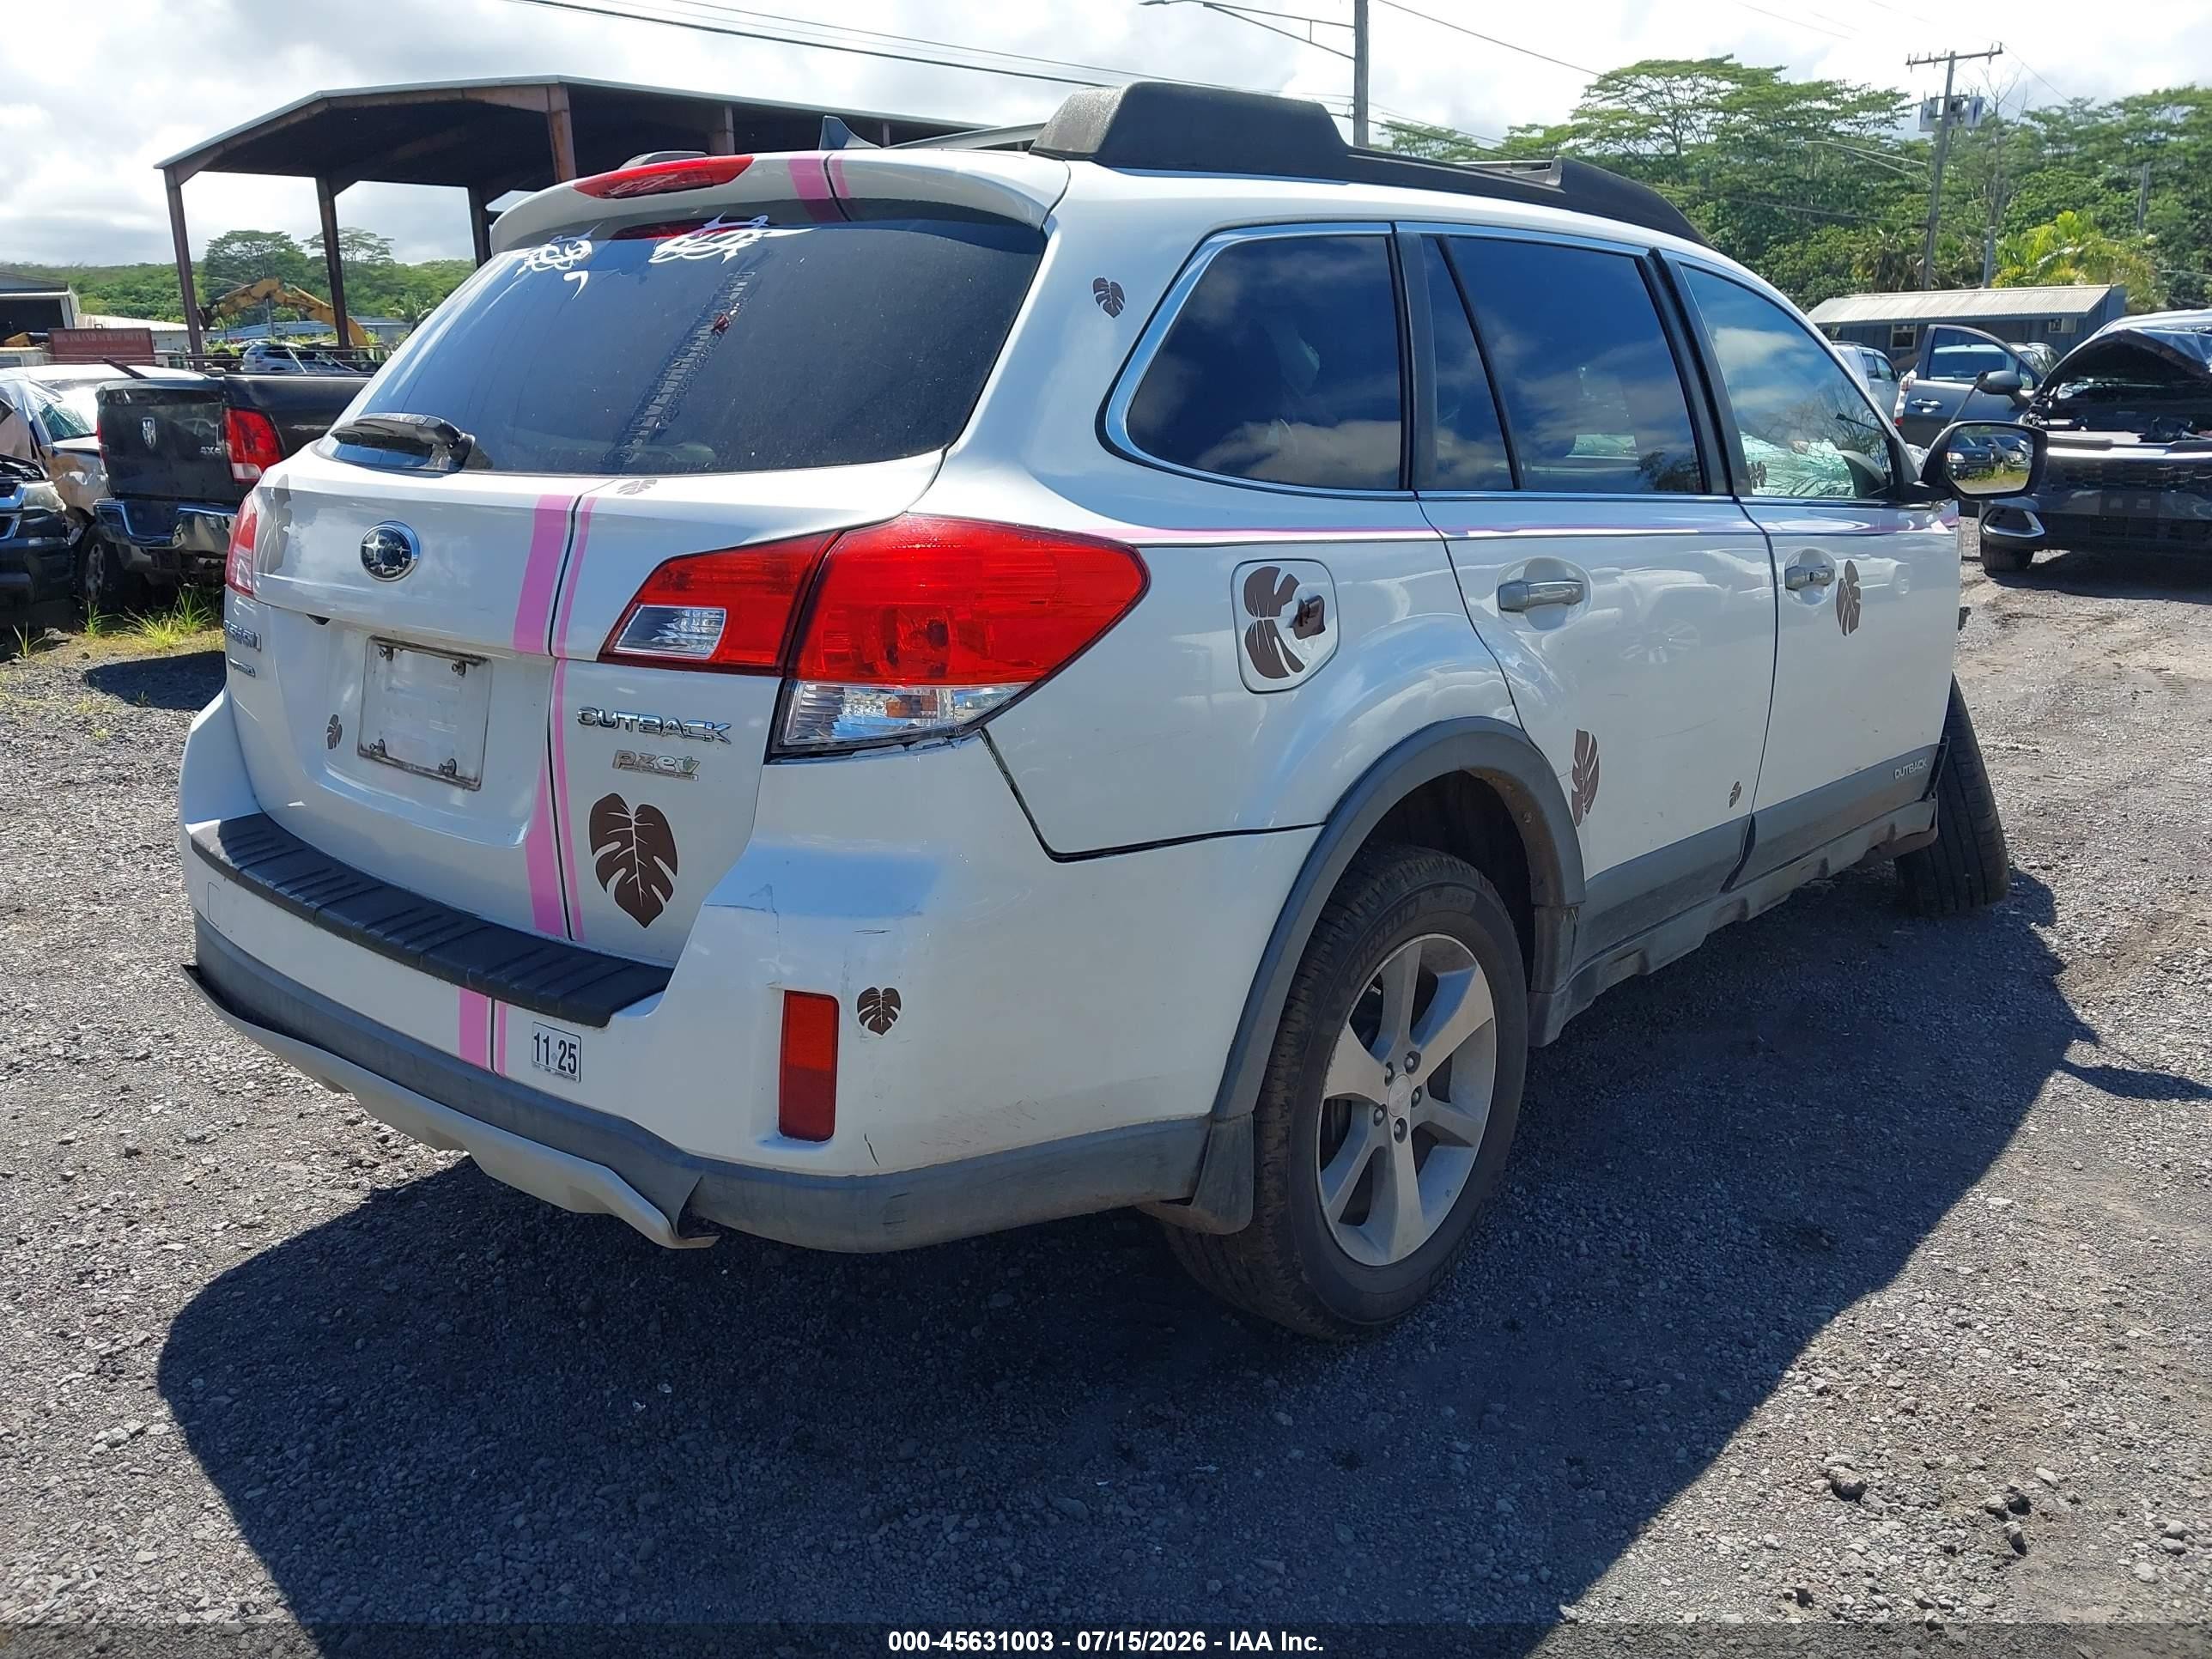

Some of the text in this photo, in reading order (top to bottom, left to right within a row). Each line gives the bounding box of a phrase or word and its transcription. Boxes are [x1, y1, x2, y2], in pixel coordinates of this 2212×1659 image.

[577, 707, 732, 744] OUTBACK
[1894, 757, 1927, 780] OUTBACK
[533, 1032, 550, 1066] 11
[557, 1039, 577, 1075] 25
